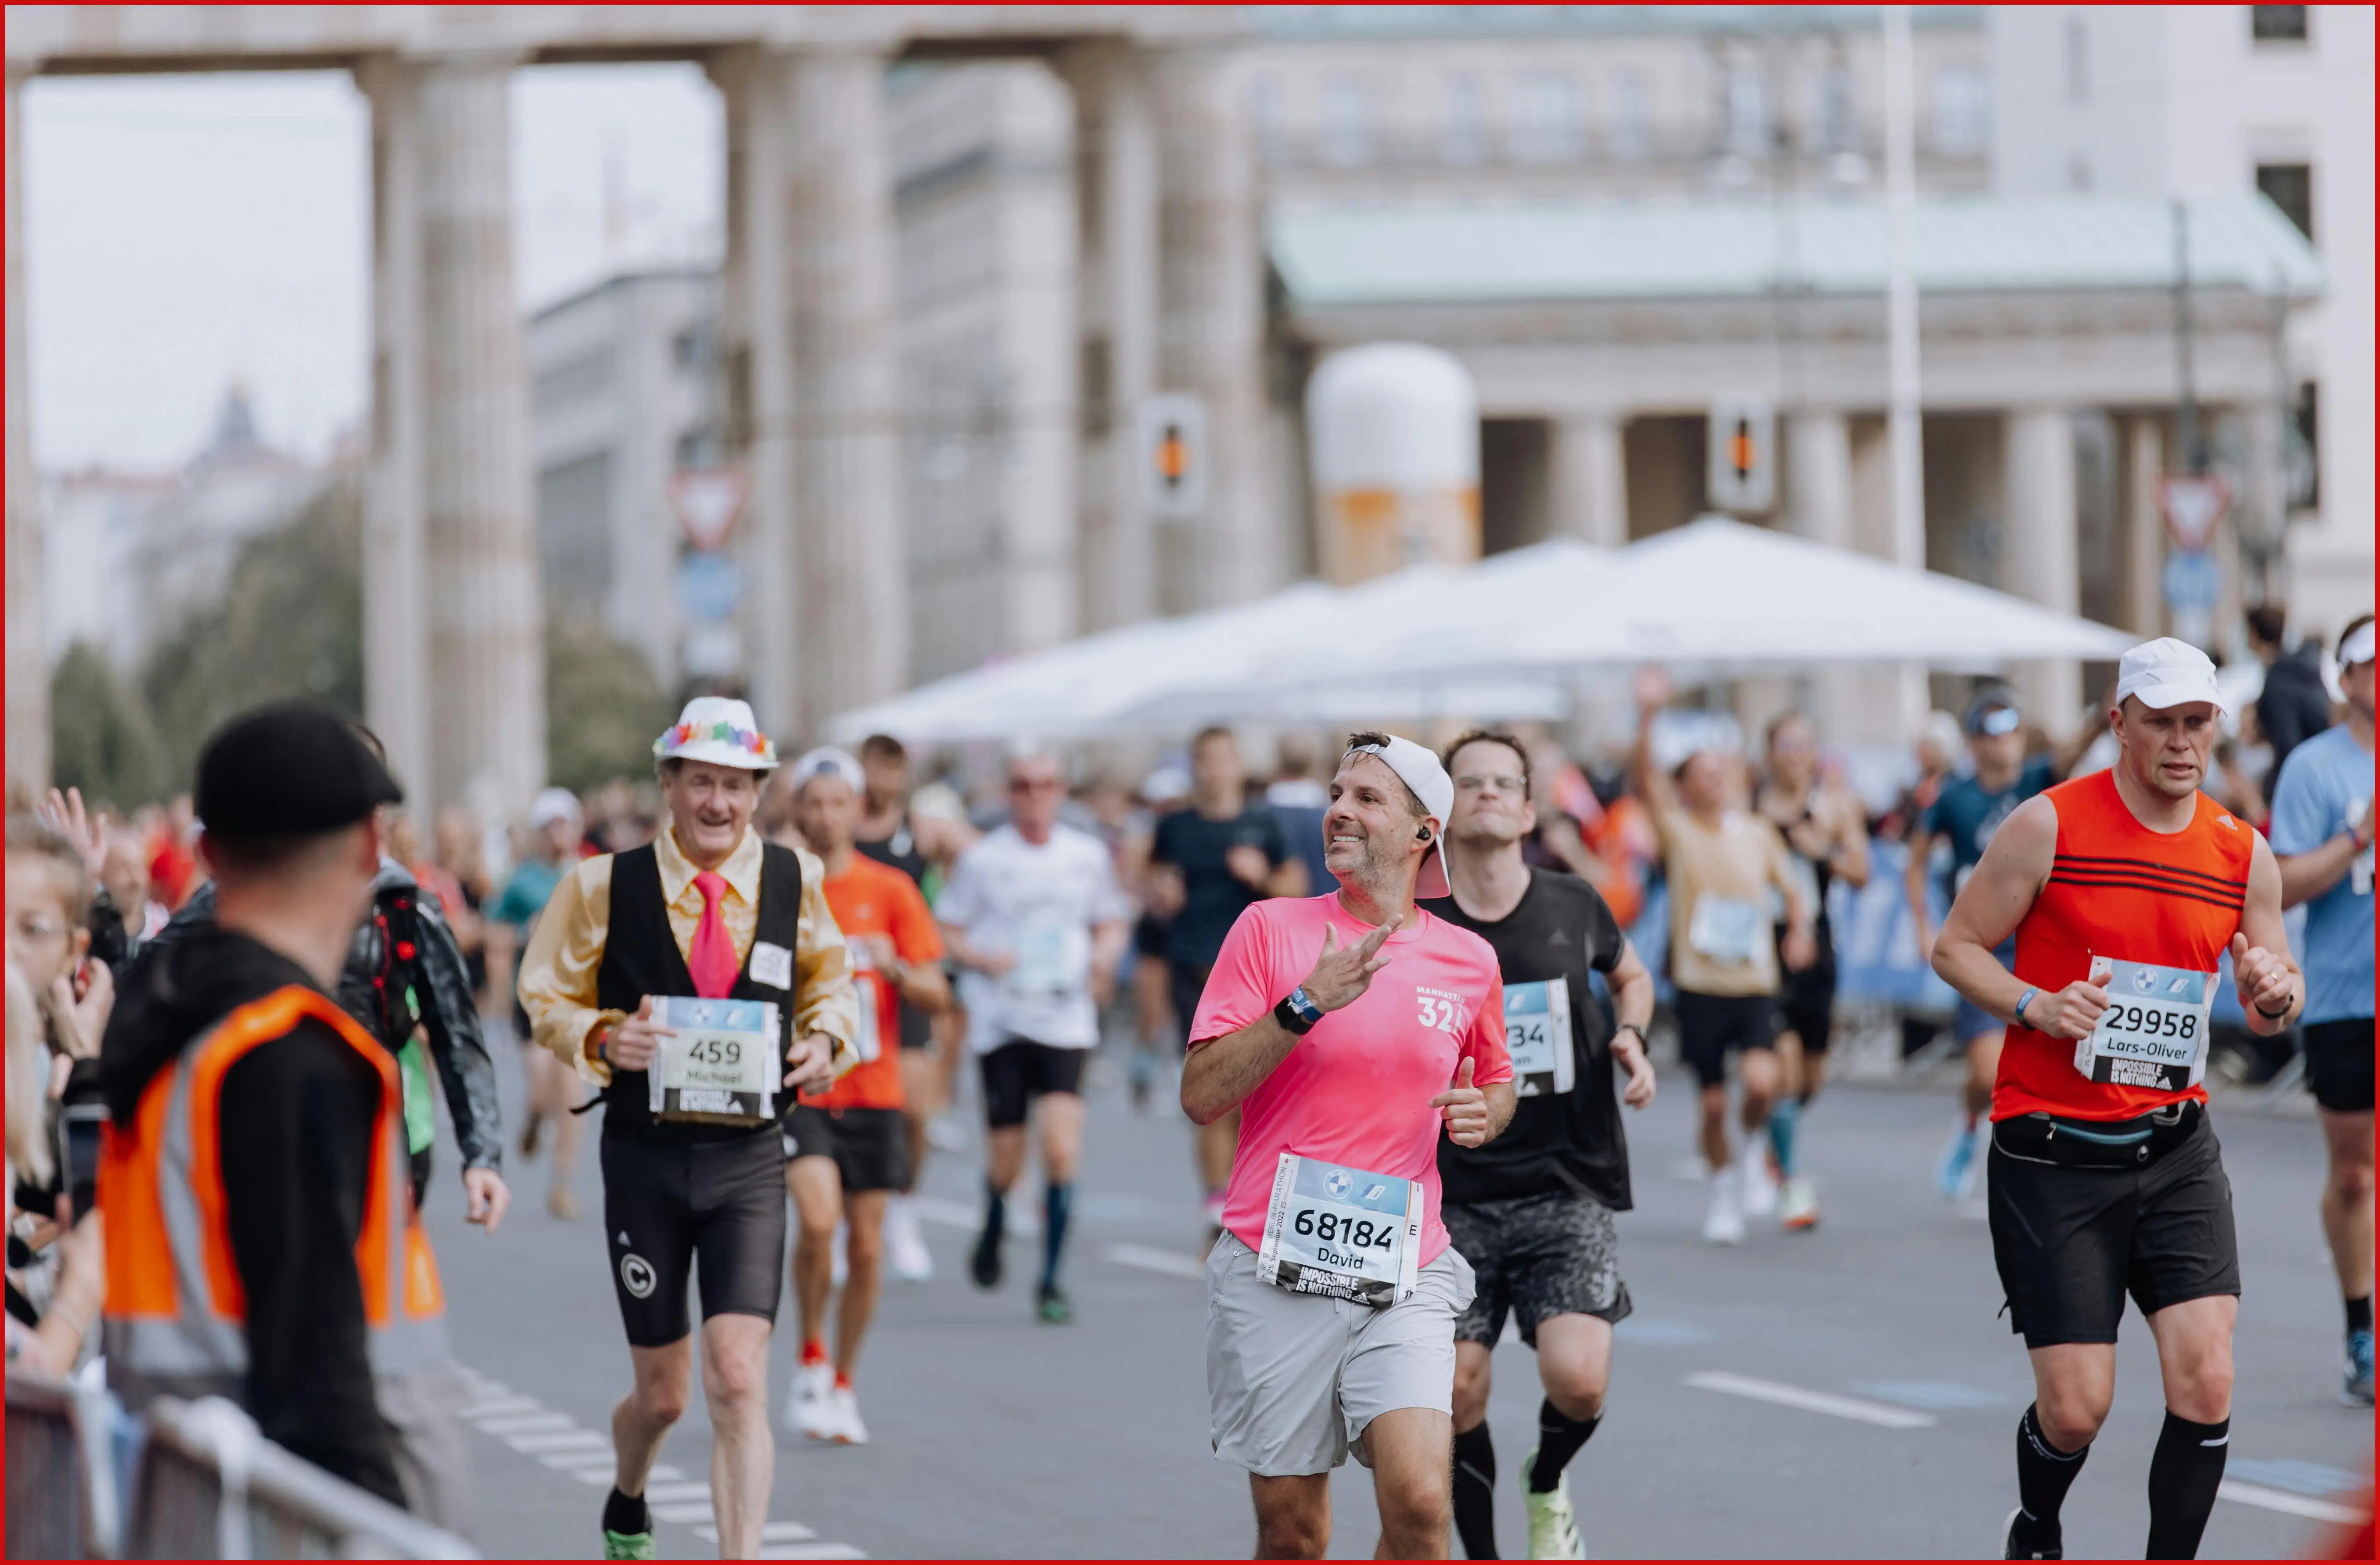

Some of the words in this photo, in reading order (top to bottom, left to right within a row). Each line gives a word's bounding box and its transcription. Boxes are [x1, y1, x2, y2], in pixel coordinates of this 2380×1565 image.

[1417, 986, 1466, 1005] MANHATTAN
[2106, 1004, 2197, 1039] 29958
[1506, 1024, 1544, 1048] 34
[689, 1040, 740, 1064] 459
[2107, 1037, 2187, 1059] Lars-Oliver
[2110, 1070, 2119, 1083] IS
[2120, 1071, 2157, 1087] NOTHING
[2111, 1058, 2163, 1077] IMPOSSIBLE
[1267, 1167, 1287, 1239] BERLIN-MARATHON
[1270, 1229, 1281, 1262] September
[1276, 1211, 1285, 1227] 2022
[1295, 1209, 1393, 1252] 68184
[1409, 1224, 1417, 1236] E
[1317, 1247, 1364, 1270] David
[1296, 1279, 1307, 1292] IS
[1307, 1281, 1353, 1299] NOTHING
[1299, 1266, 1359, 1291] IMPOSSIBLE
[1352, 1295, 1370, 1305] adidas
